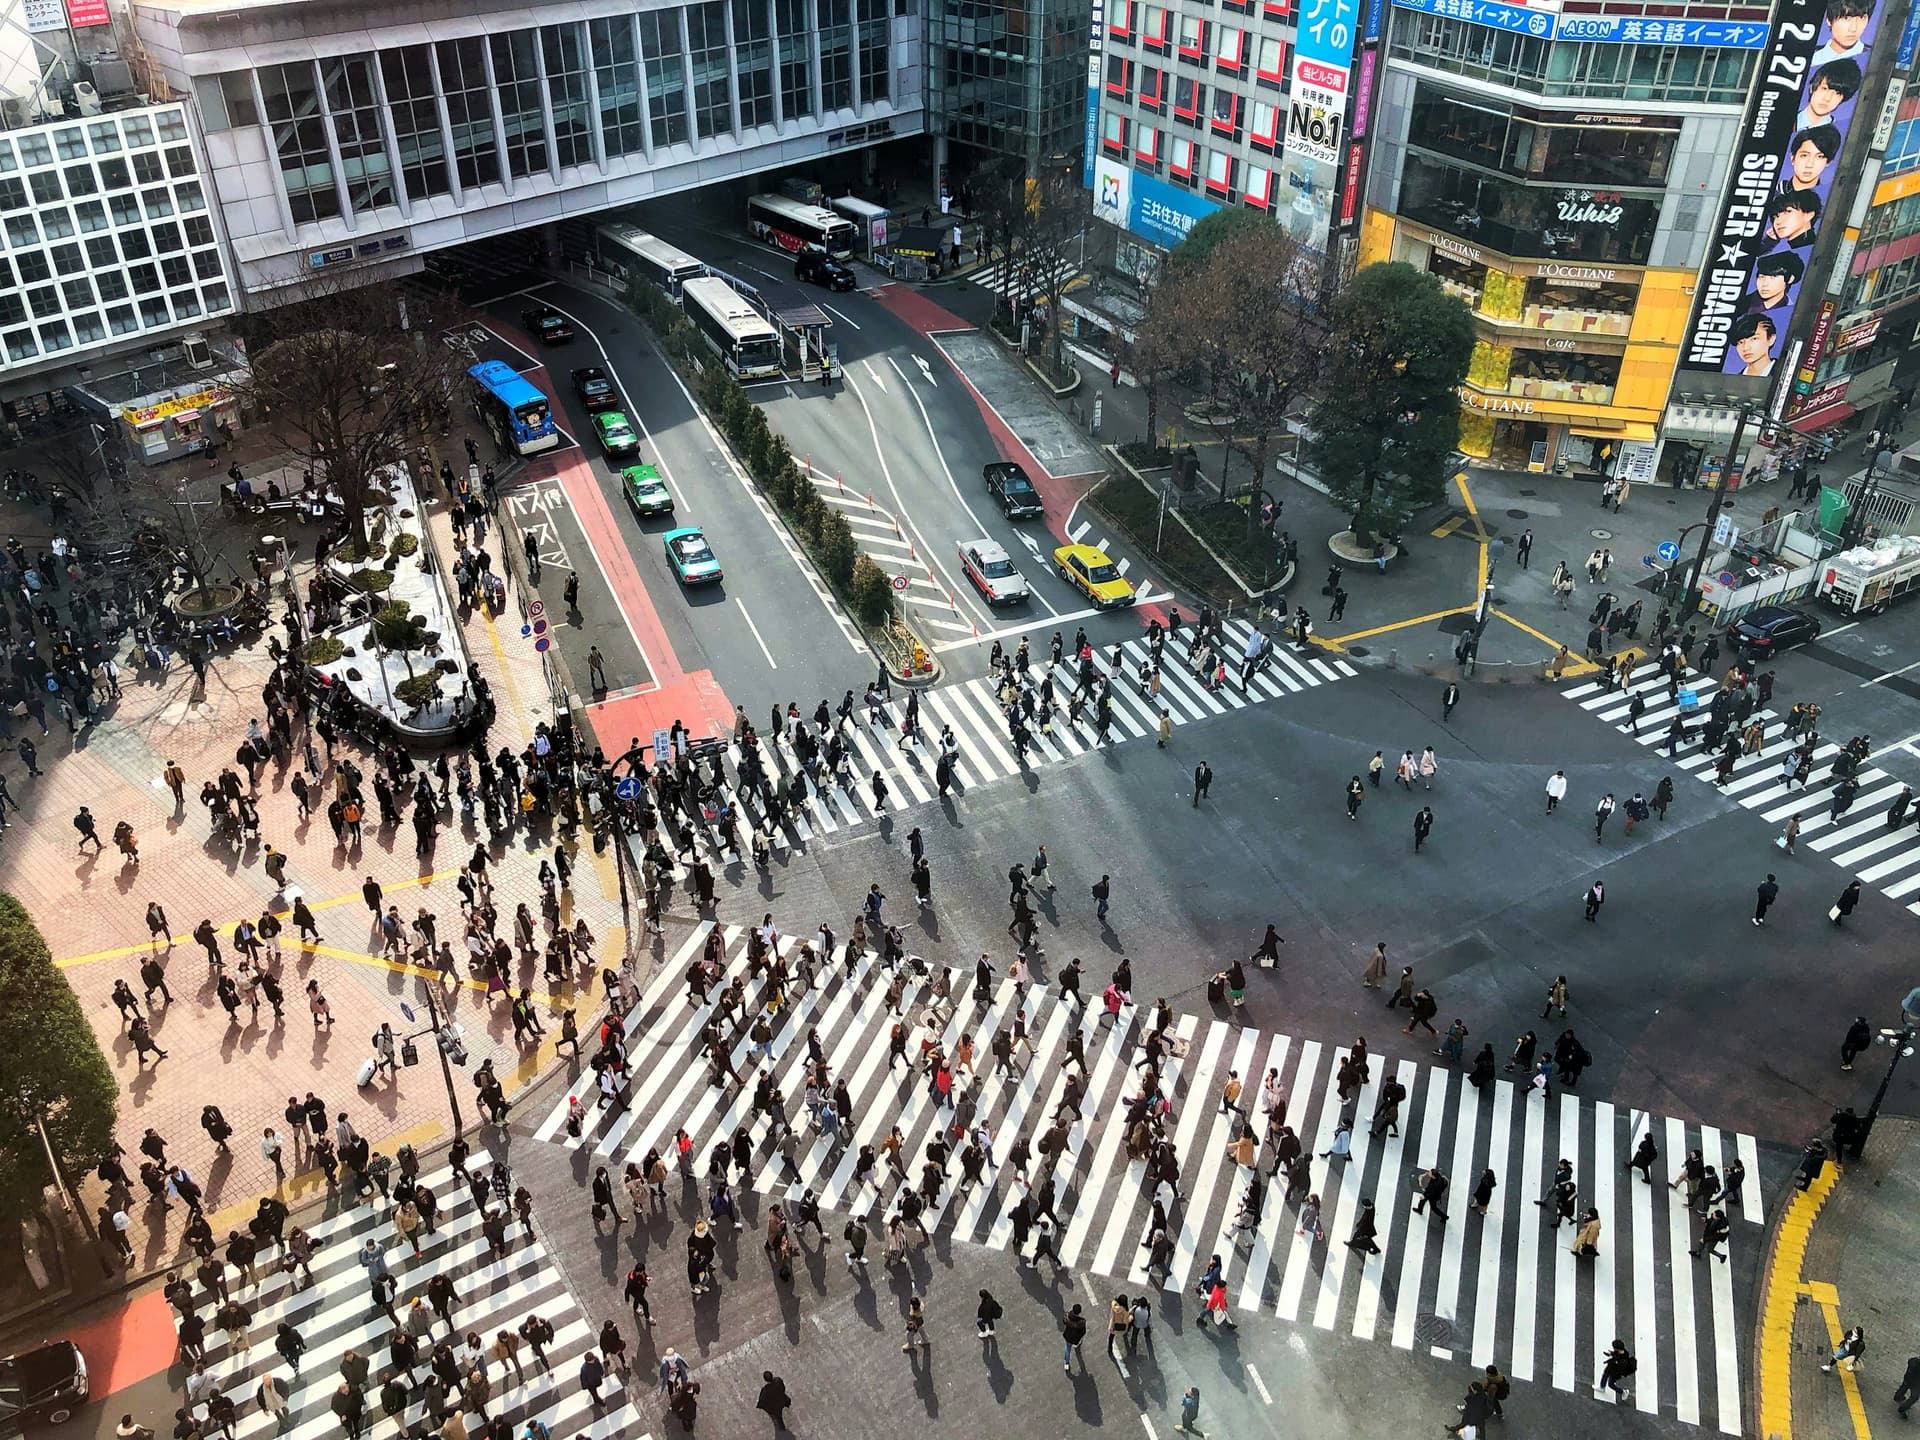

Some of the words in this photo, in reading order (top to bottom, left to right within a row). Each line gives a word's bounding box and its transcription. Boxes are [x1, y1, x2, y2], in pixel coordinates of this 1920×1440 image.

[1433, 0, 1525, 28] 英会話イーオン
[1530, 15, 1546, 32] 6F
[1565, 22, 1611, 36] AEON
[1621, 20, 1765, 45] 英会話イーオン
[1766, 22, 1816, 91] 2.27
[1303, 65, 1343, 89] 当ビル5階
[1302, 87, 1333, 107] 利用者数
[1288, 100, 1342, 151] No.1
[1752, 91, 1780, 139] Release
[1286, 138, 1337, 162] コンタクトショップ
[1723, 153, 1779, 239] SUPER
[1428, 232, 1481, 261] L'OCCITANE
[1537, 263, 1616, 281] L'OCCITANE
[1688, 268, 1747, 364] DRAGON
[1546, 337, 1576, 349] Cafe
